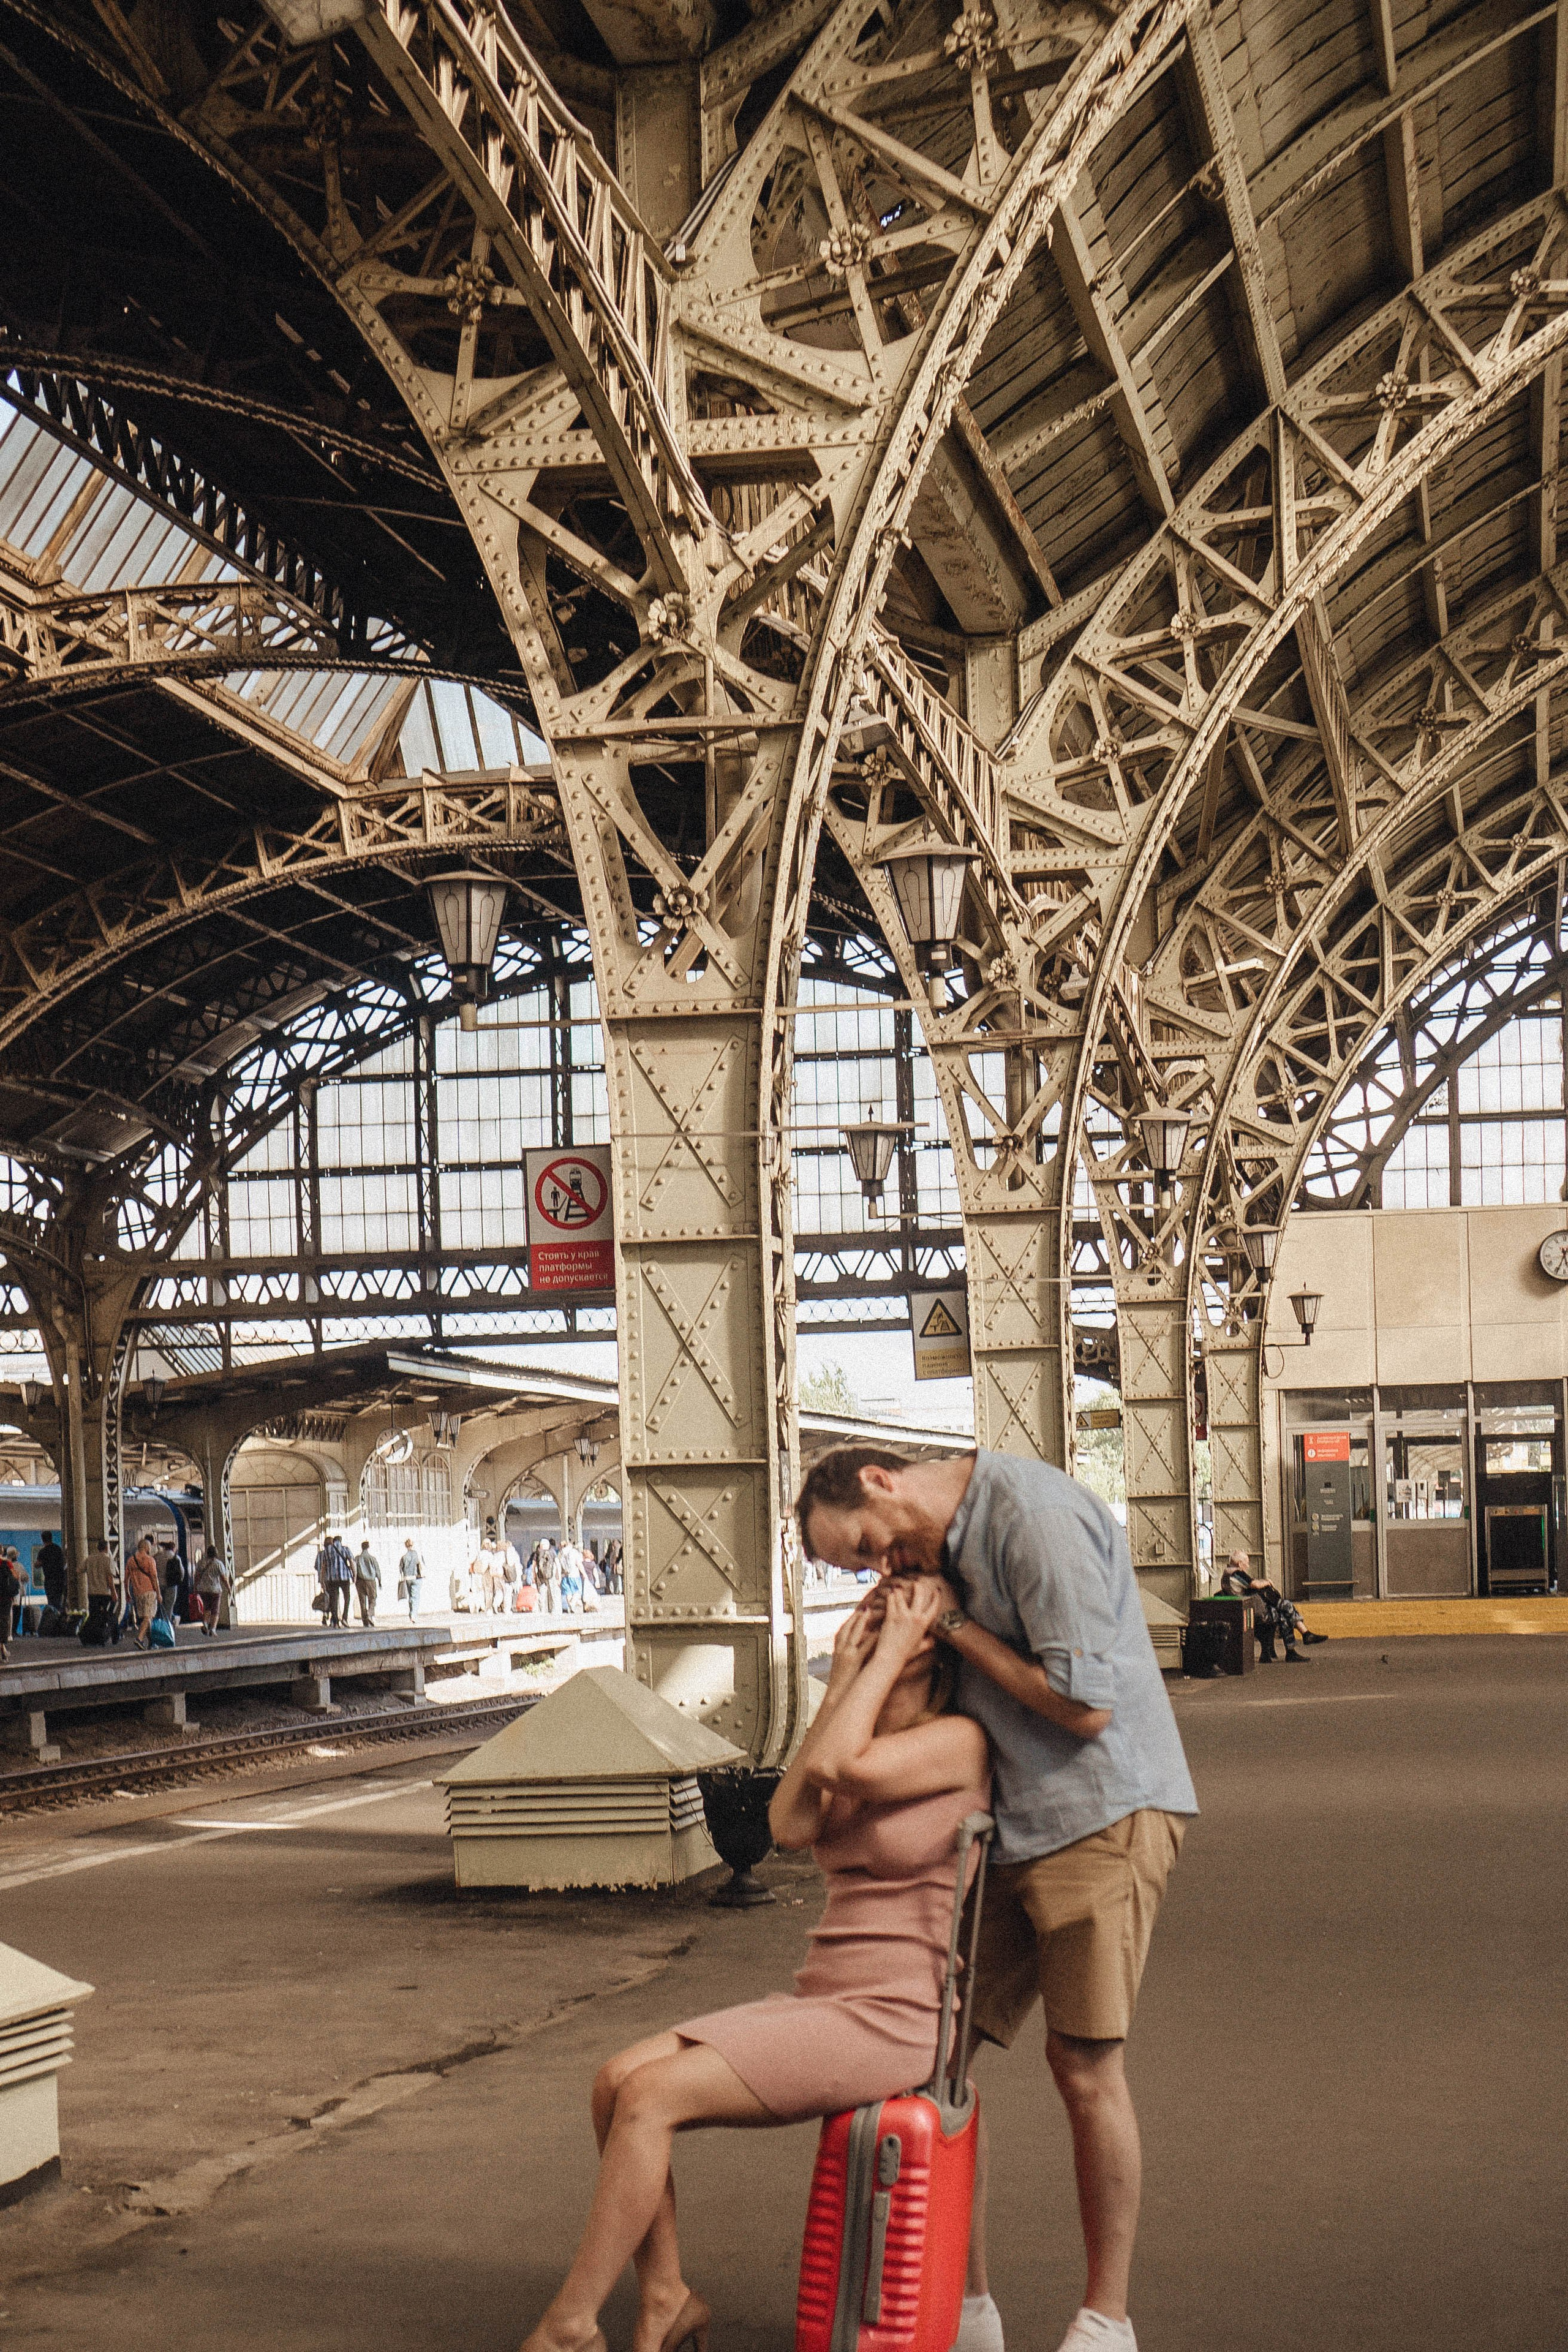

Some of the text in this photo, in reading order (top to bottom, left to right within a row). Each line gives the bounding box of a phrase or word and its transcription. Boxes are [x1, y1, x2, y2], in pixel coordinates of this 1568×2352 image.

[538, 1251, 568, 1261] Стоять
[578, 1251, 599, 1259] края
[539, 1262, 592, 1273] платформы
[552, 1274, 608, 1284] допускается
